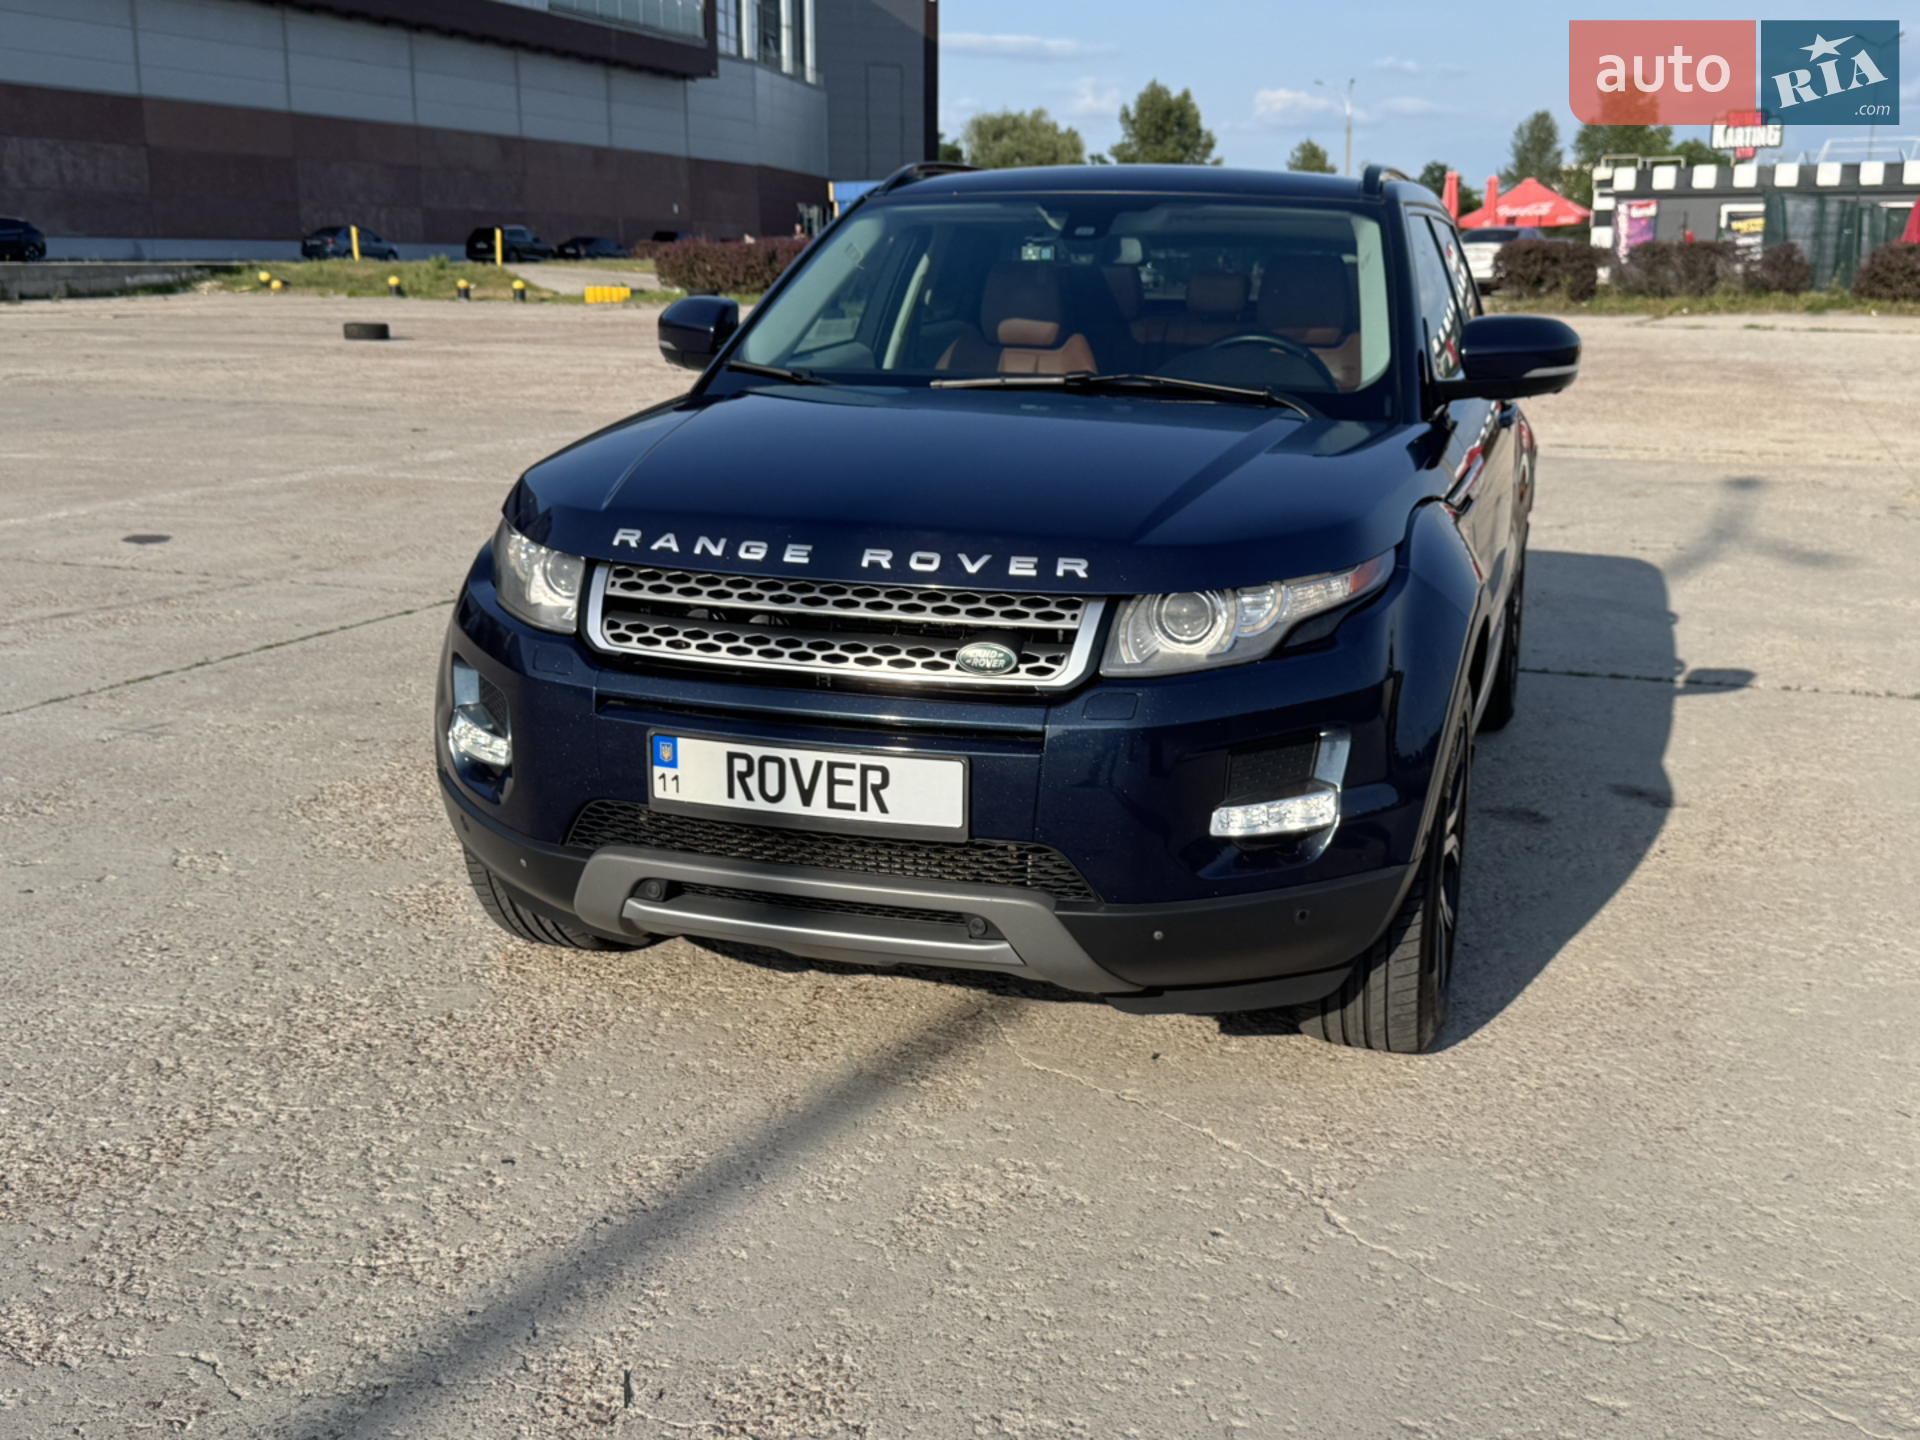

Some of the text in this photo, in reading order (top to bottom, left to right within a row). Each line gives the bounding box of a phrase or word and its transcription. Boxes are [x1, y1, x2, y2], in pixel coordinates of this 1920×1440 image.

[612, 528, 1089, 578] RANGE ROVER
[658, 772, 679, 794] 11
[726, 750, 890, 814] ROVER
